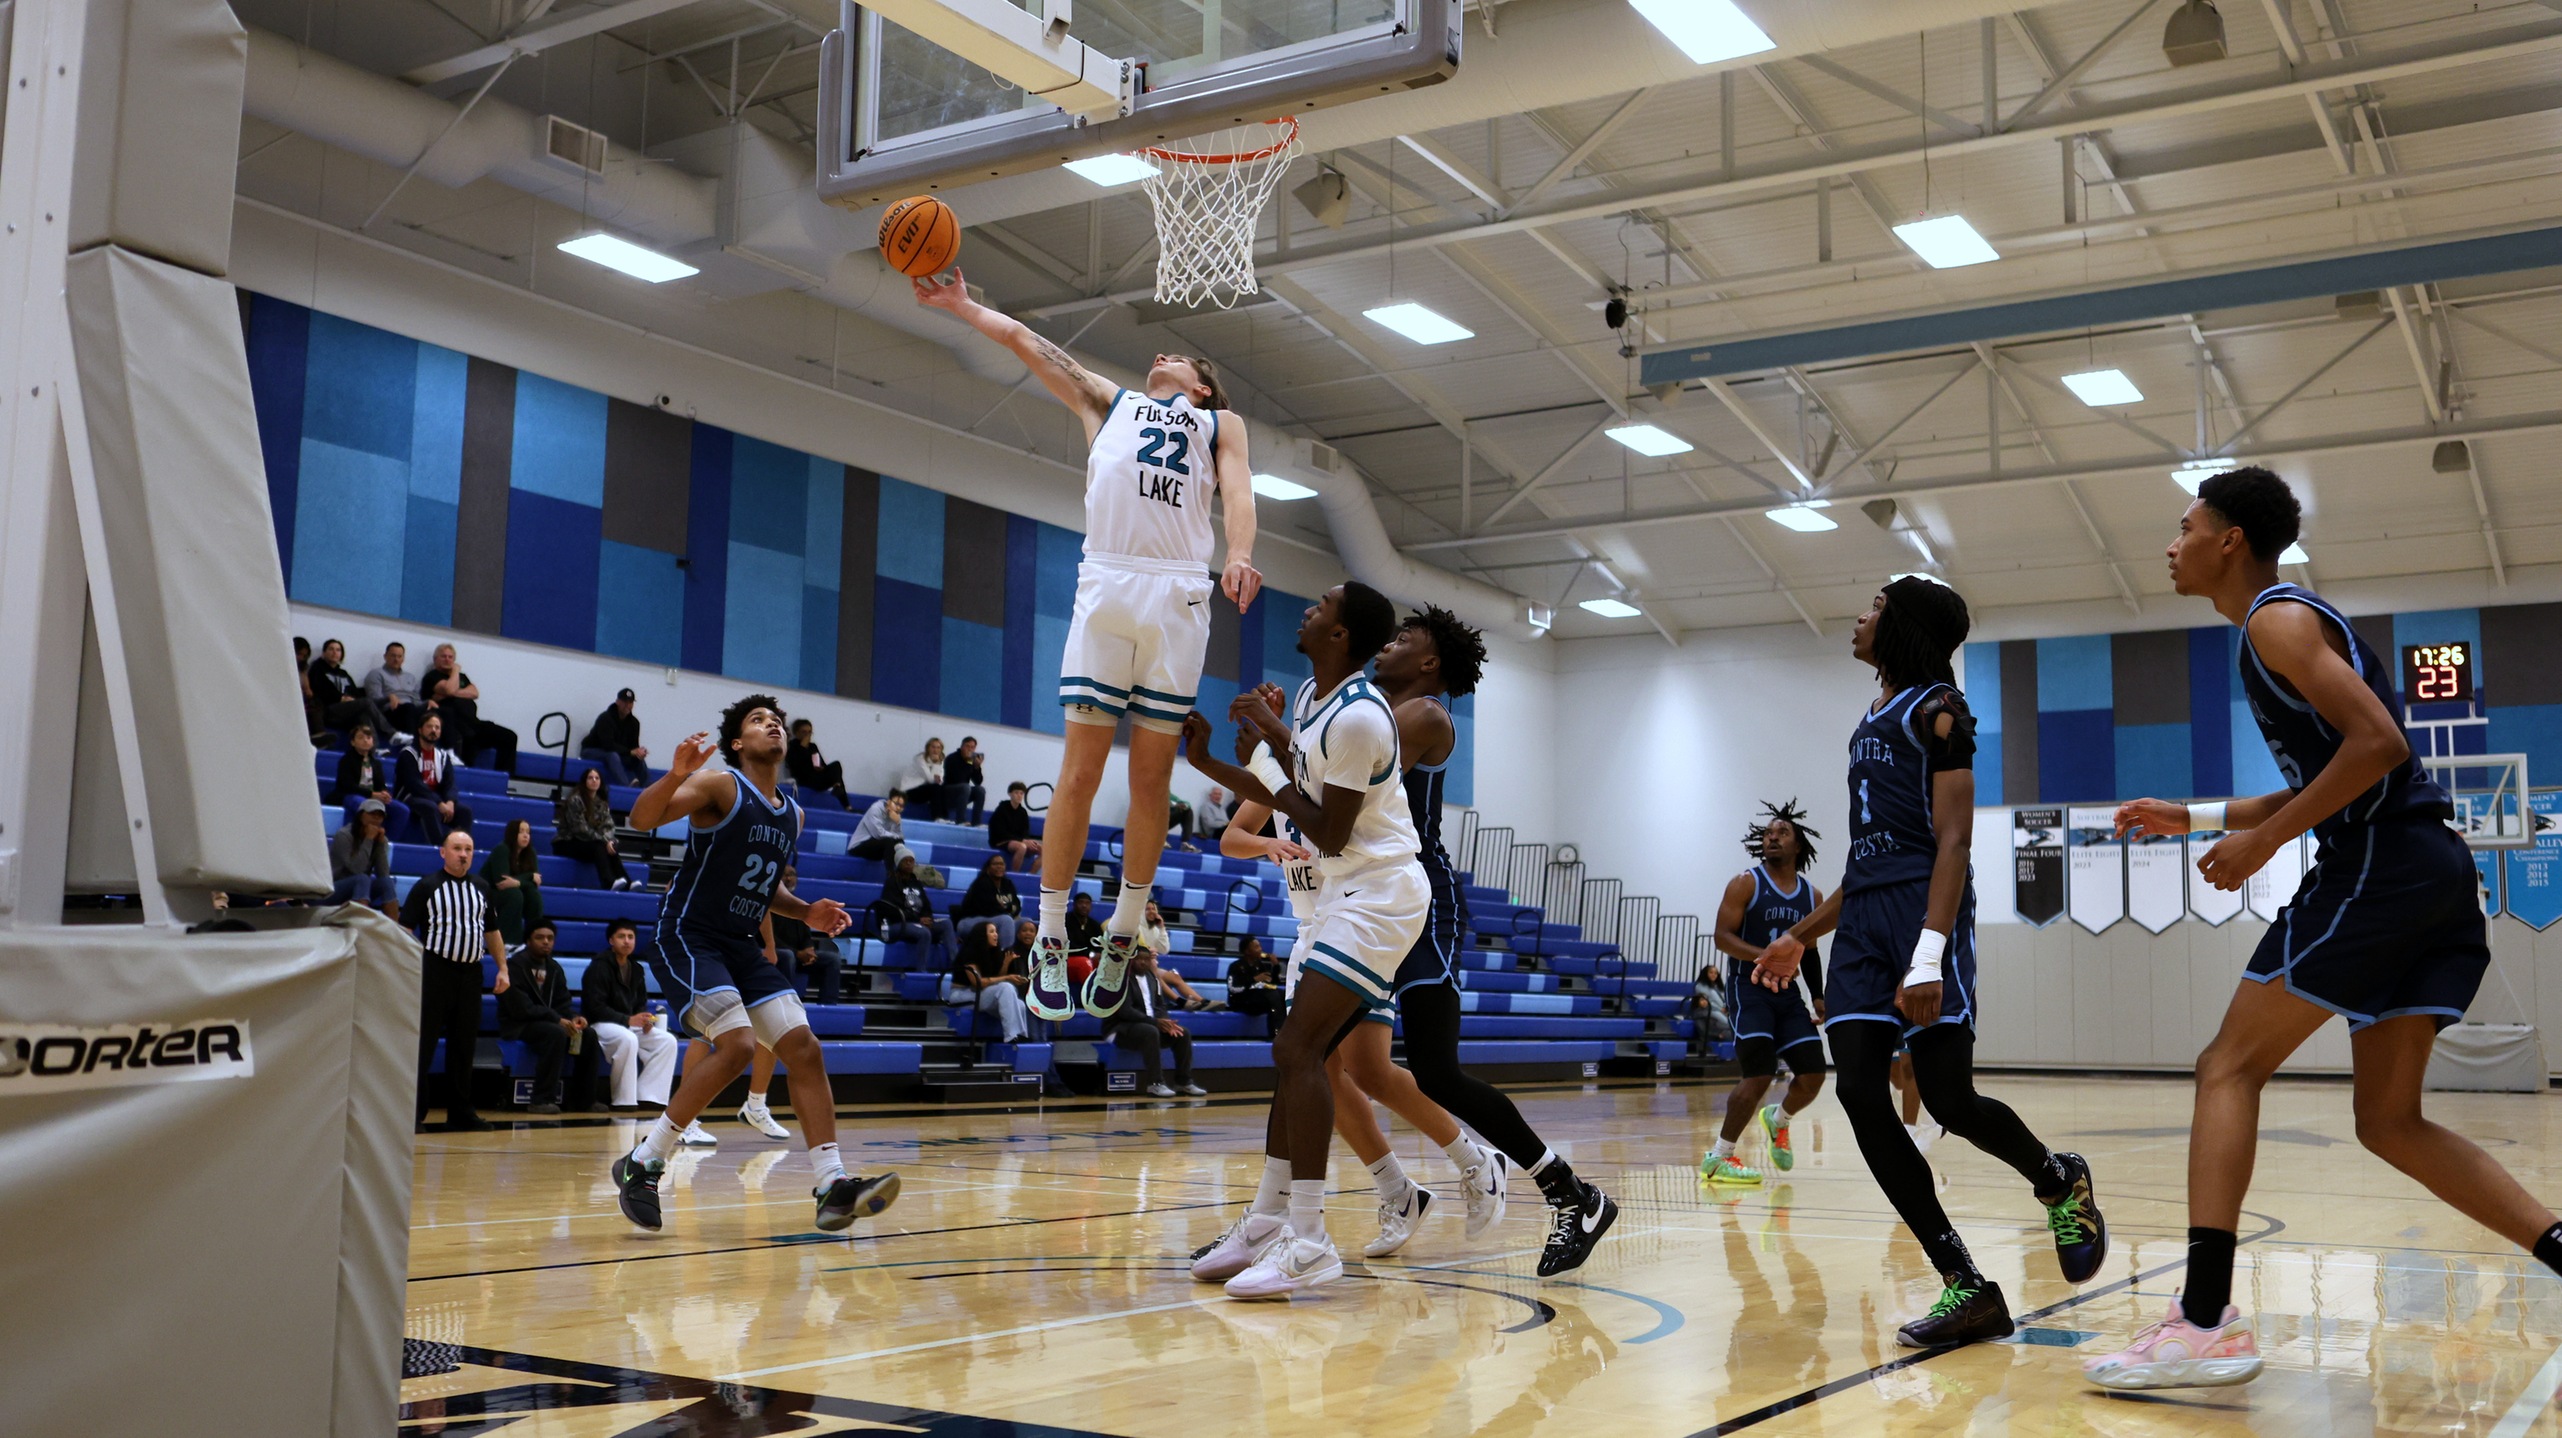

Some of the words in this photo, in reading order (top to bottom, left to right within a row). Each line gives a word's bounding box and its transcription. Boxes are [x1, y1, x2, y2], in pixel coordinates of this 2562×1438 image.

[1134, 404, 1198, 432] FOLSOM
[1137, 427, 1189, 475] 22
[1140, 471, 1183, 508] LAKE
[2414, 645, 2465, 667] 17:26
[2417, 666, 2458, 698] 23
[1850, 737, 1895, 768] ONTRA
[1858, 778, 1872, 825] 1
[748, 824, 792, 858] CONTRA
[2015, 850, 2038, 858] FINAL
[2040, 849, 2063, 857] FOUR
[2536, 839, 2562, 848] ALLEY
[737, 853, 778, 897] 22
[1286, 866, 1317, 892] LAKE
[729, 895, 766, 922] COSTA
